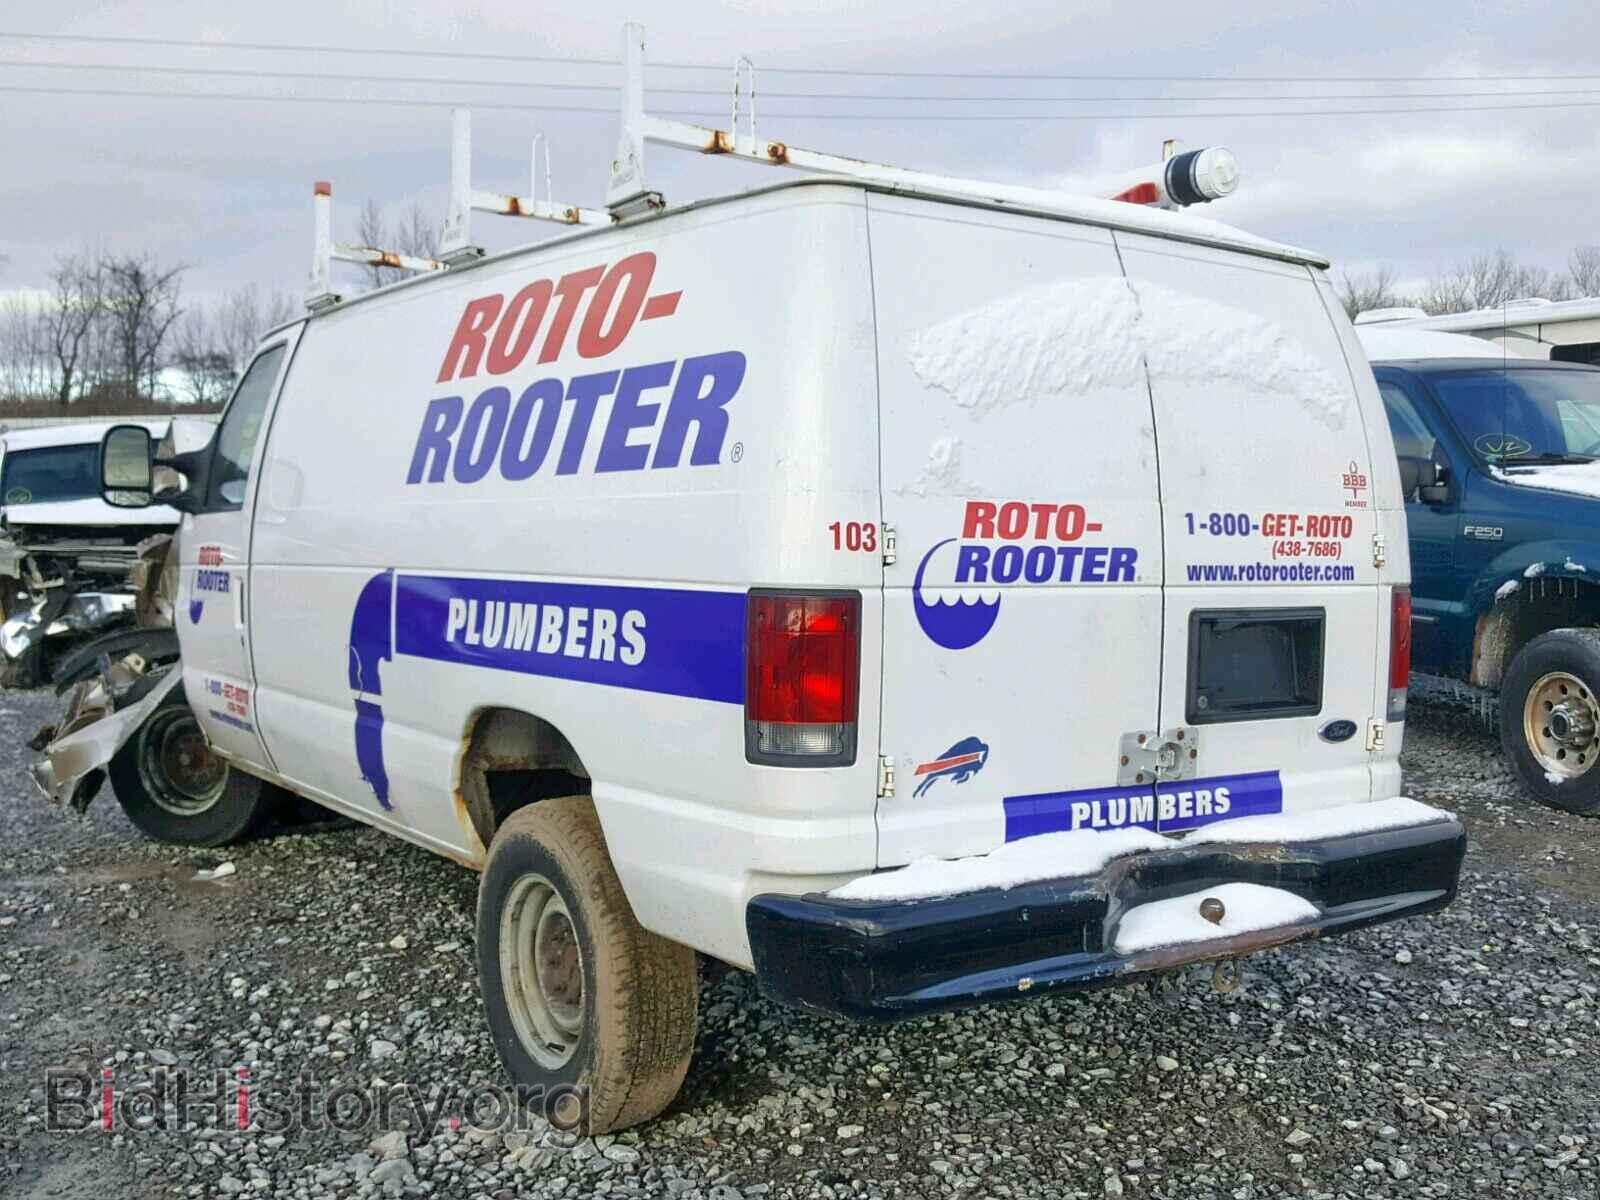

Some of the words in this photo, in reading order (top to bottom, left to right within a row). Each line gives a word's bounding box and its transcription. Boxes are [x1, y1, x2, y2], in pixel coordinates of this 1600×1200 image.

[436, 251, 683, 383] ROTO-
[406, 350, 747, 485] ROOTER
[1343, 474, 1367, 486] BBB
[828, 521, 876, 551] 103
[962, 501, 1103, 541] ROTO-
[1464, 526, 1503, 537] F250
[954, 545, 1138, 584] ROOTER
[1272, 541, 1342, 560] (438-7686)
[197, 569, 230, 592] ROOTER
[1187, 562, 1355, 582] www.rotorooter.com
[446, 597, 647, 666] PLUMBERS
[1071, 788, 1231, 830] PLUMBERS
